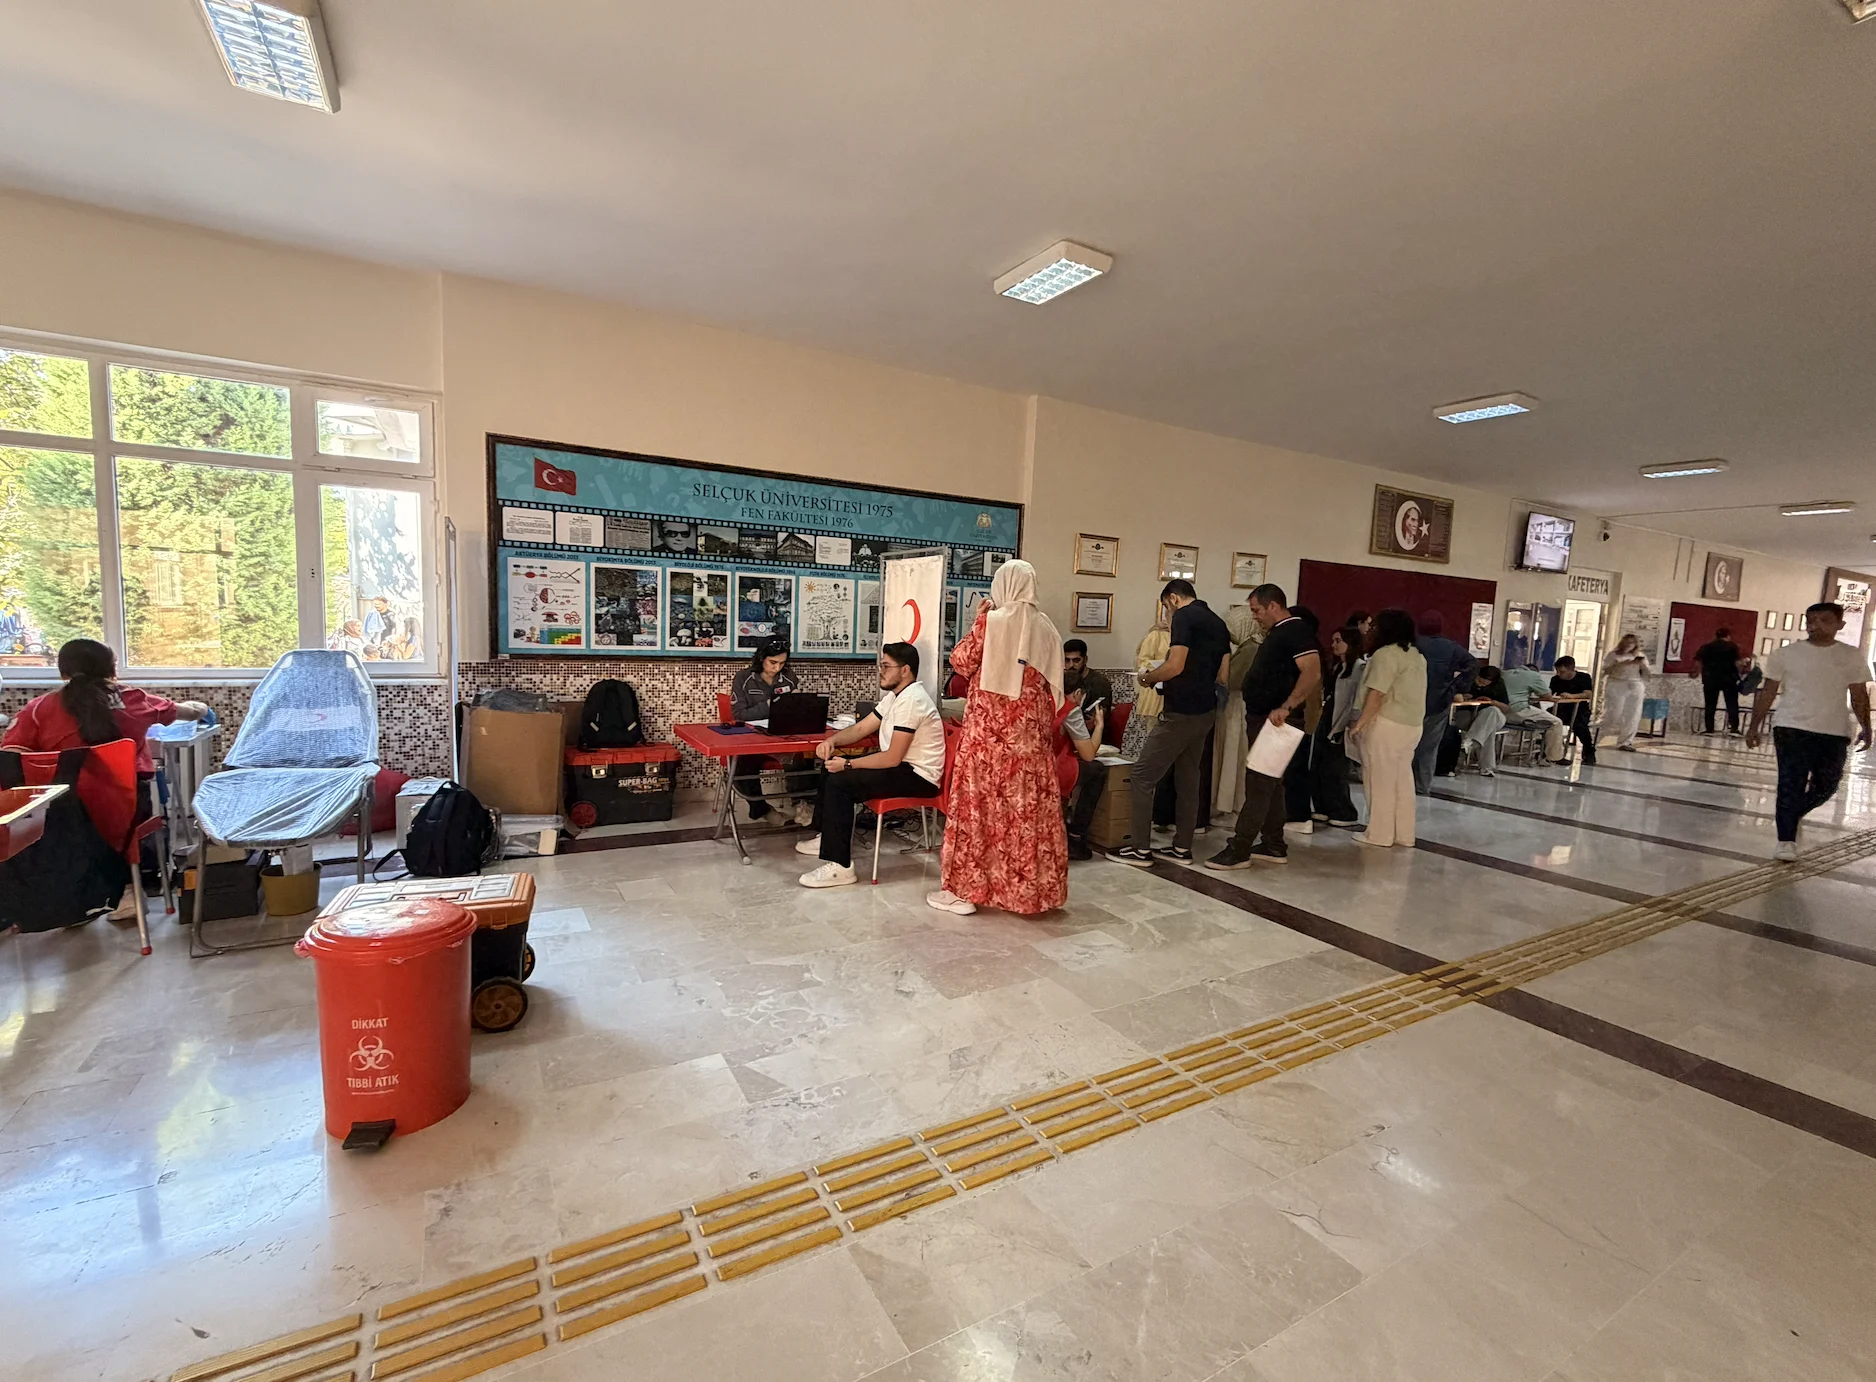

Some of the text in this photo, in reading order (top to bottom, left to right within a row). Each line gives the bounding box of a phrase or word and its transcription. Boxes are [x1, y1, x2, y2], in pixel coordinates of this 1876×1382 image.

[693, 484, 893, 518] SELÇUK ÜNİVERSİTESİ 1975
[741, 507, 854, 528] FEN FAKÜLTESİ 1976
[352, 1017, 389, 1029] DİKKAT
[346, 1073, 399, 1088] TIBBİ ATIK
